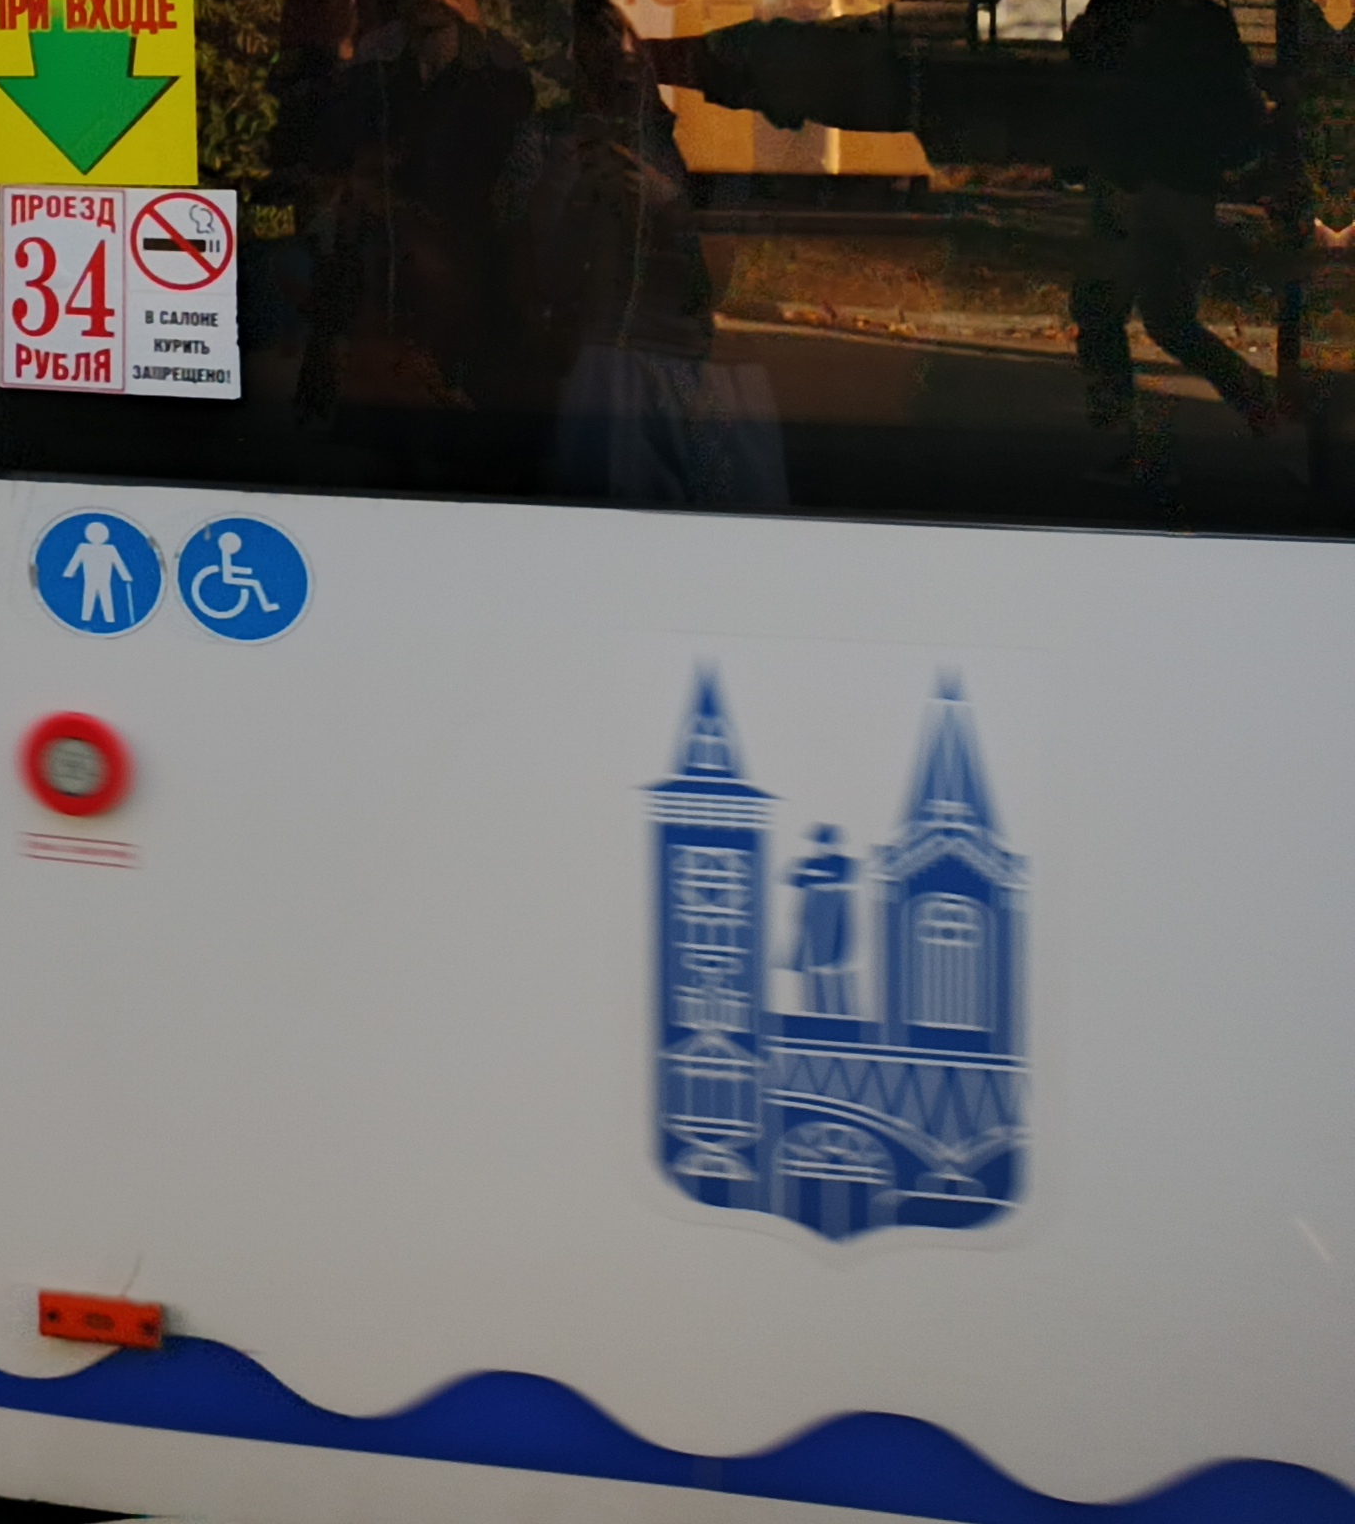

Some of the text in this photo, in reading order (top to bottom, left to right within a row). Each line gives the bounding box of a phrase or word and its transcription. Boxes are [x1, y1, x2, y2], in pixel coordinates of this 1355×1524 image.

[10, 194, 117, 234] ПРОЕЗД
[12, 236, 116, 338] 34
[145, 310, 219, 327] В САЛОНЕ
[153, 338, 210, 355] КУРИТЬ
[15, 342, 112, 383] РУБЛЯ
[132, 365, 232, 385] ЗАПРЕЩЕНО!
